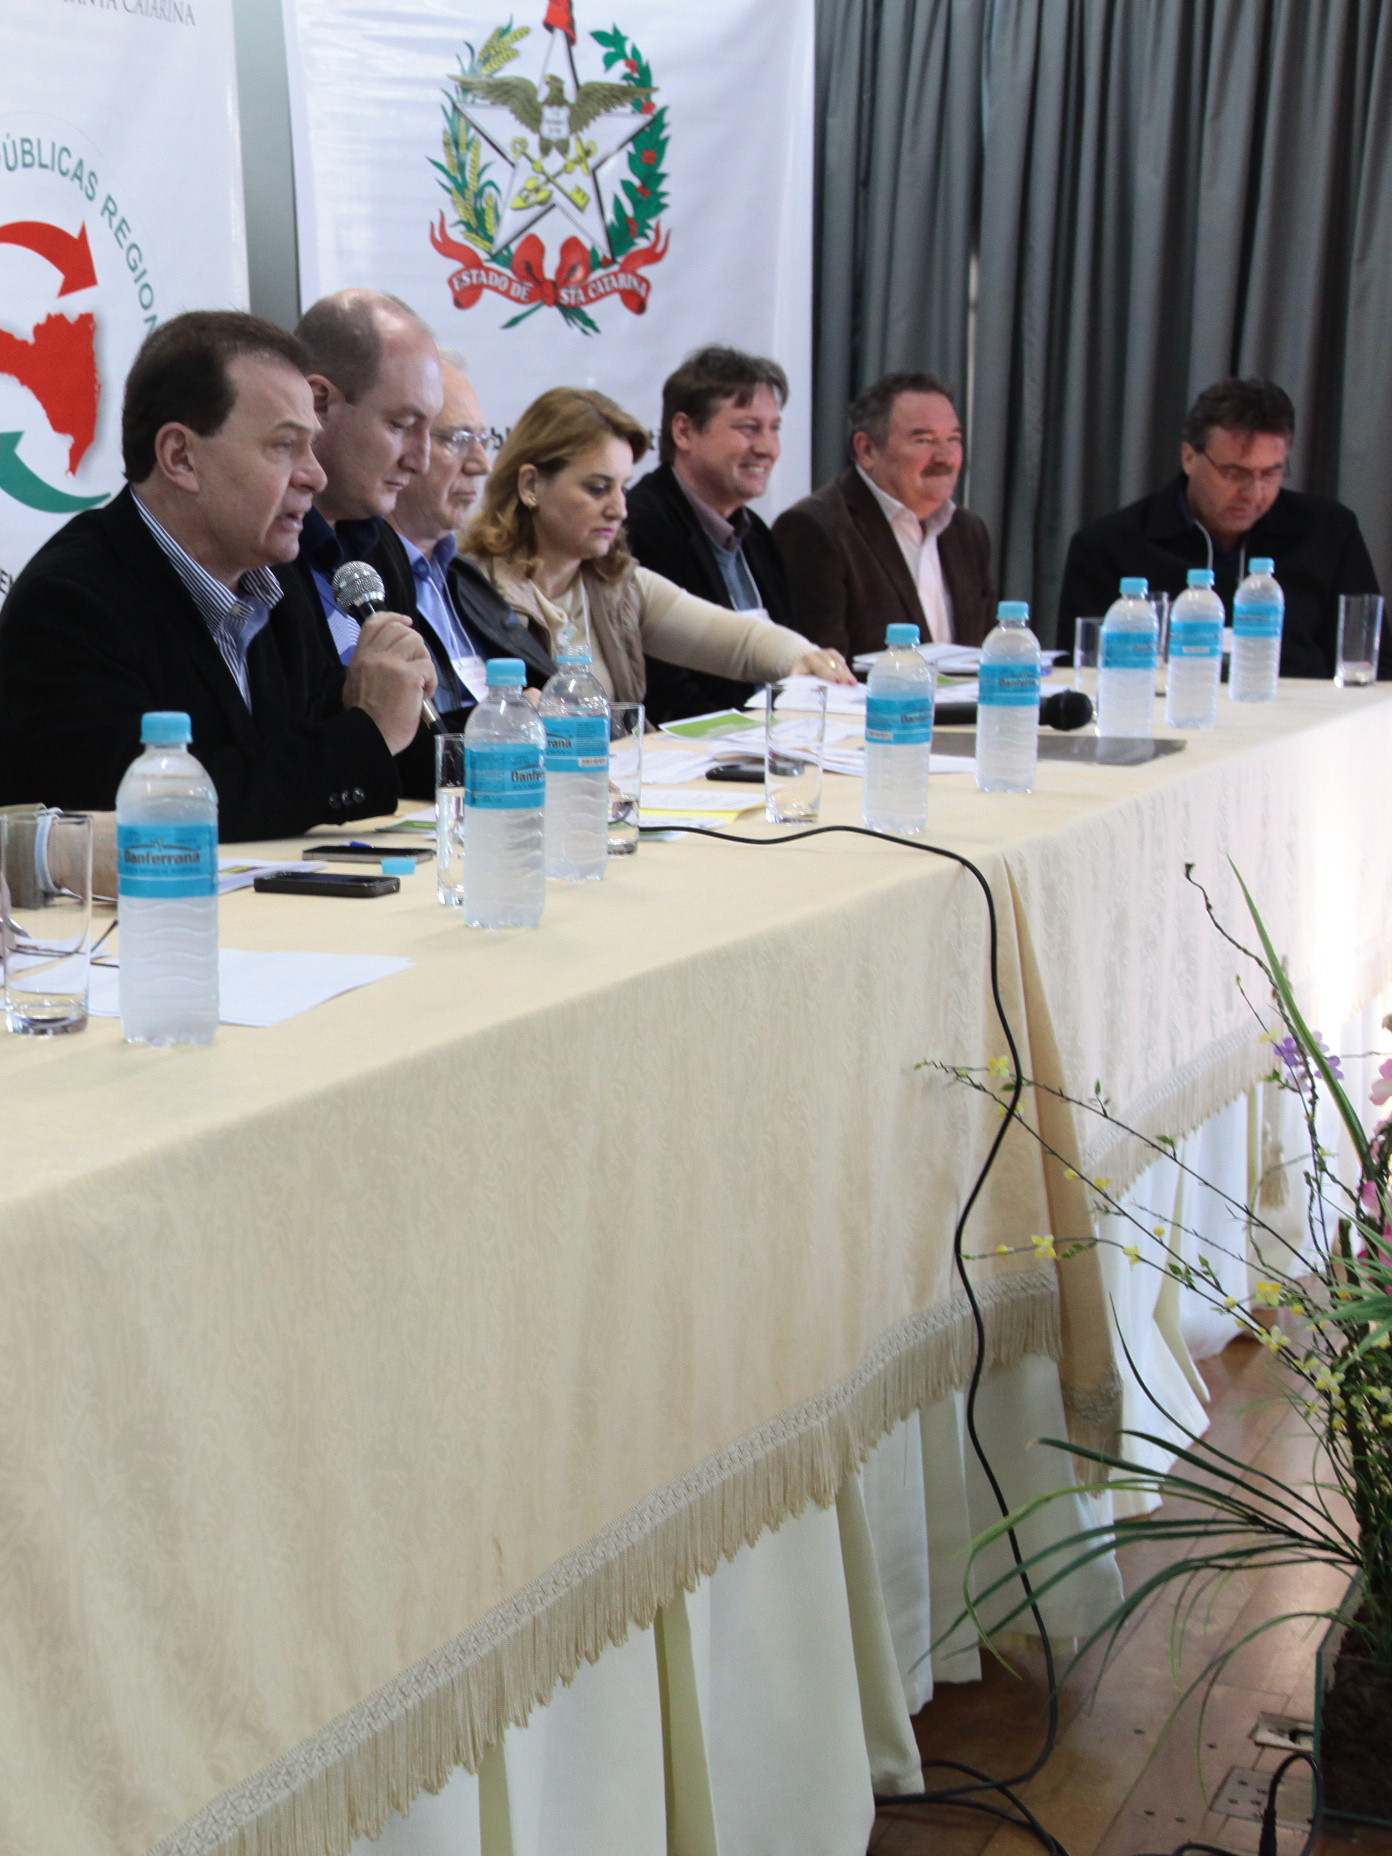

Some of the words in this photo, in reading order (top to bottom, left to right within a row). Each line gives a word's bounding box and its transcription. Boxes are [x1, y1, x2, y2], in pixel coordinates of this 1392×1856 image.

[101, 194, 158, 336] REGION
[453, 269, 509, 291] ESTADO
[510, 283, 530, 301] DE
